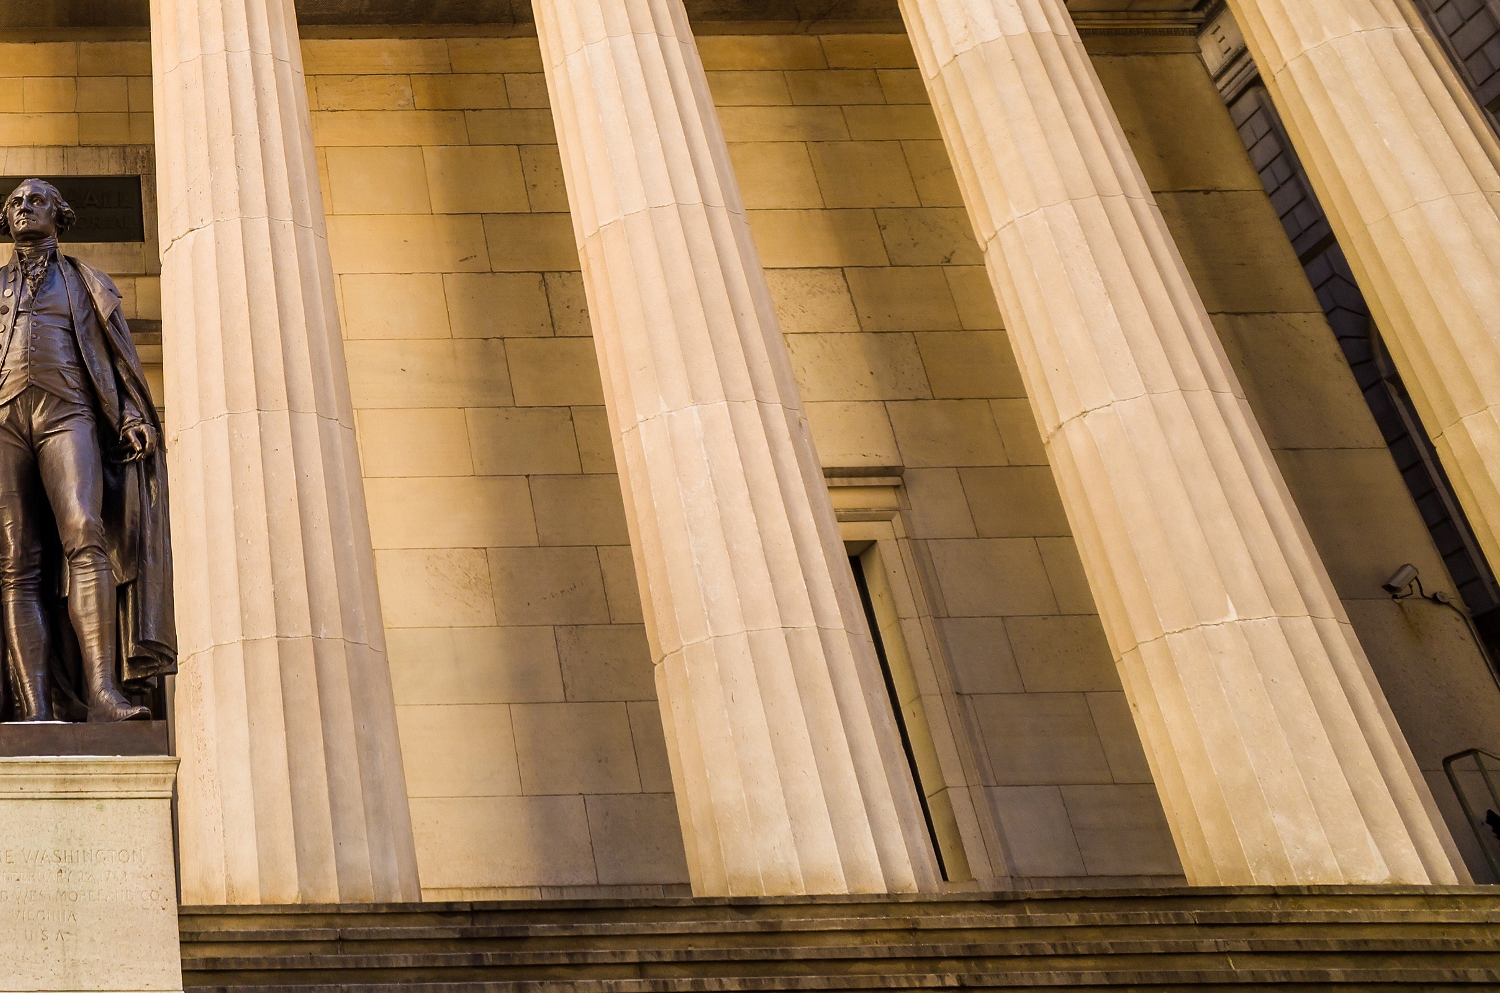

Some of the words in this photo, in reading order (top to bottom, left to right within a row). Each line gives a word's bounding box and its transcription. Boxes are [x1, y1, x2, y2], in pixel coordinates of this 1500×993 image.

[75, 215, 134, 230] ORIAL
[20, 849, 144, 864] WASHINGTON
[12, 909, 77, 922] VIRGINIA
